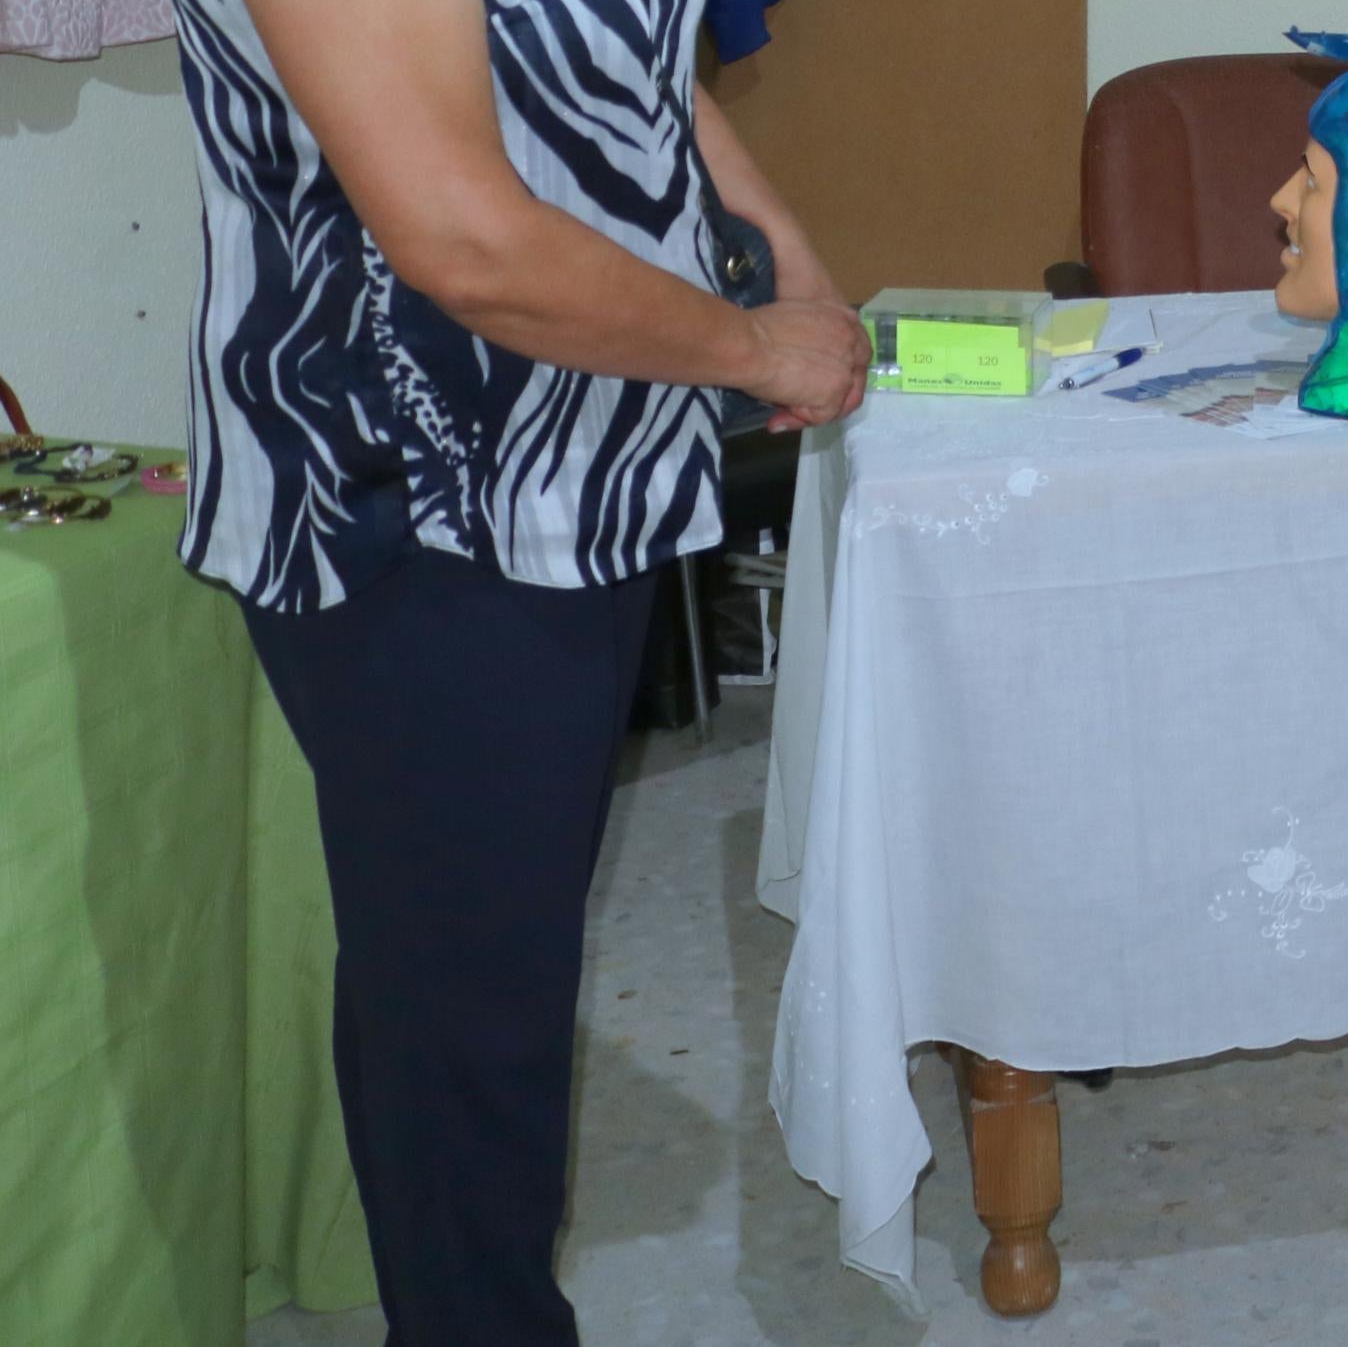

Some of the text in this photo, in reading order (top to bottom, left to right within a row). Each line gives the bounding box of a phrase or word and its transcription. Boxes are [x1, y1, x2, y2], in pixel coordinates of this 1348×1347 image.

[912, 353, 933, 364] 120
[977, 355, 999, 366] 120
[964, 379, 1002, 387] Unidas
